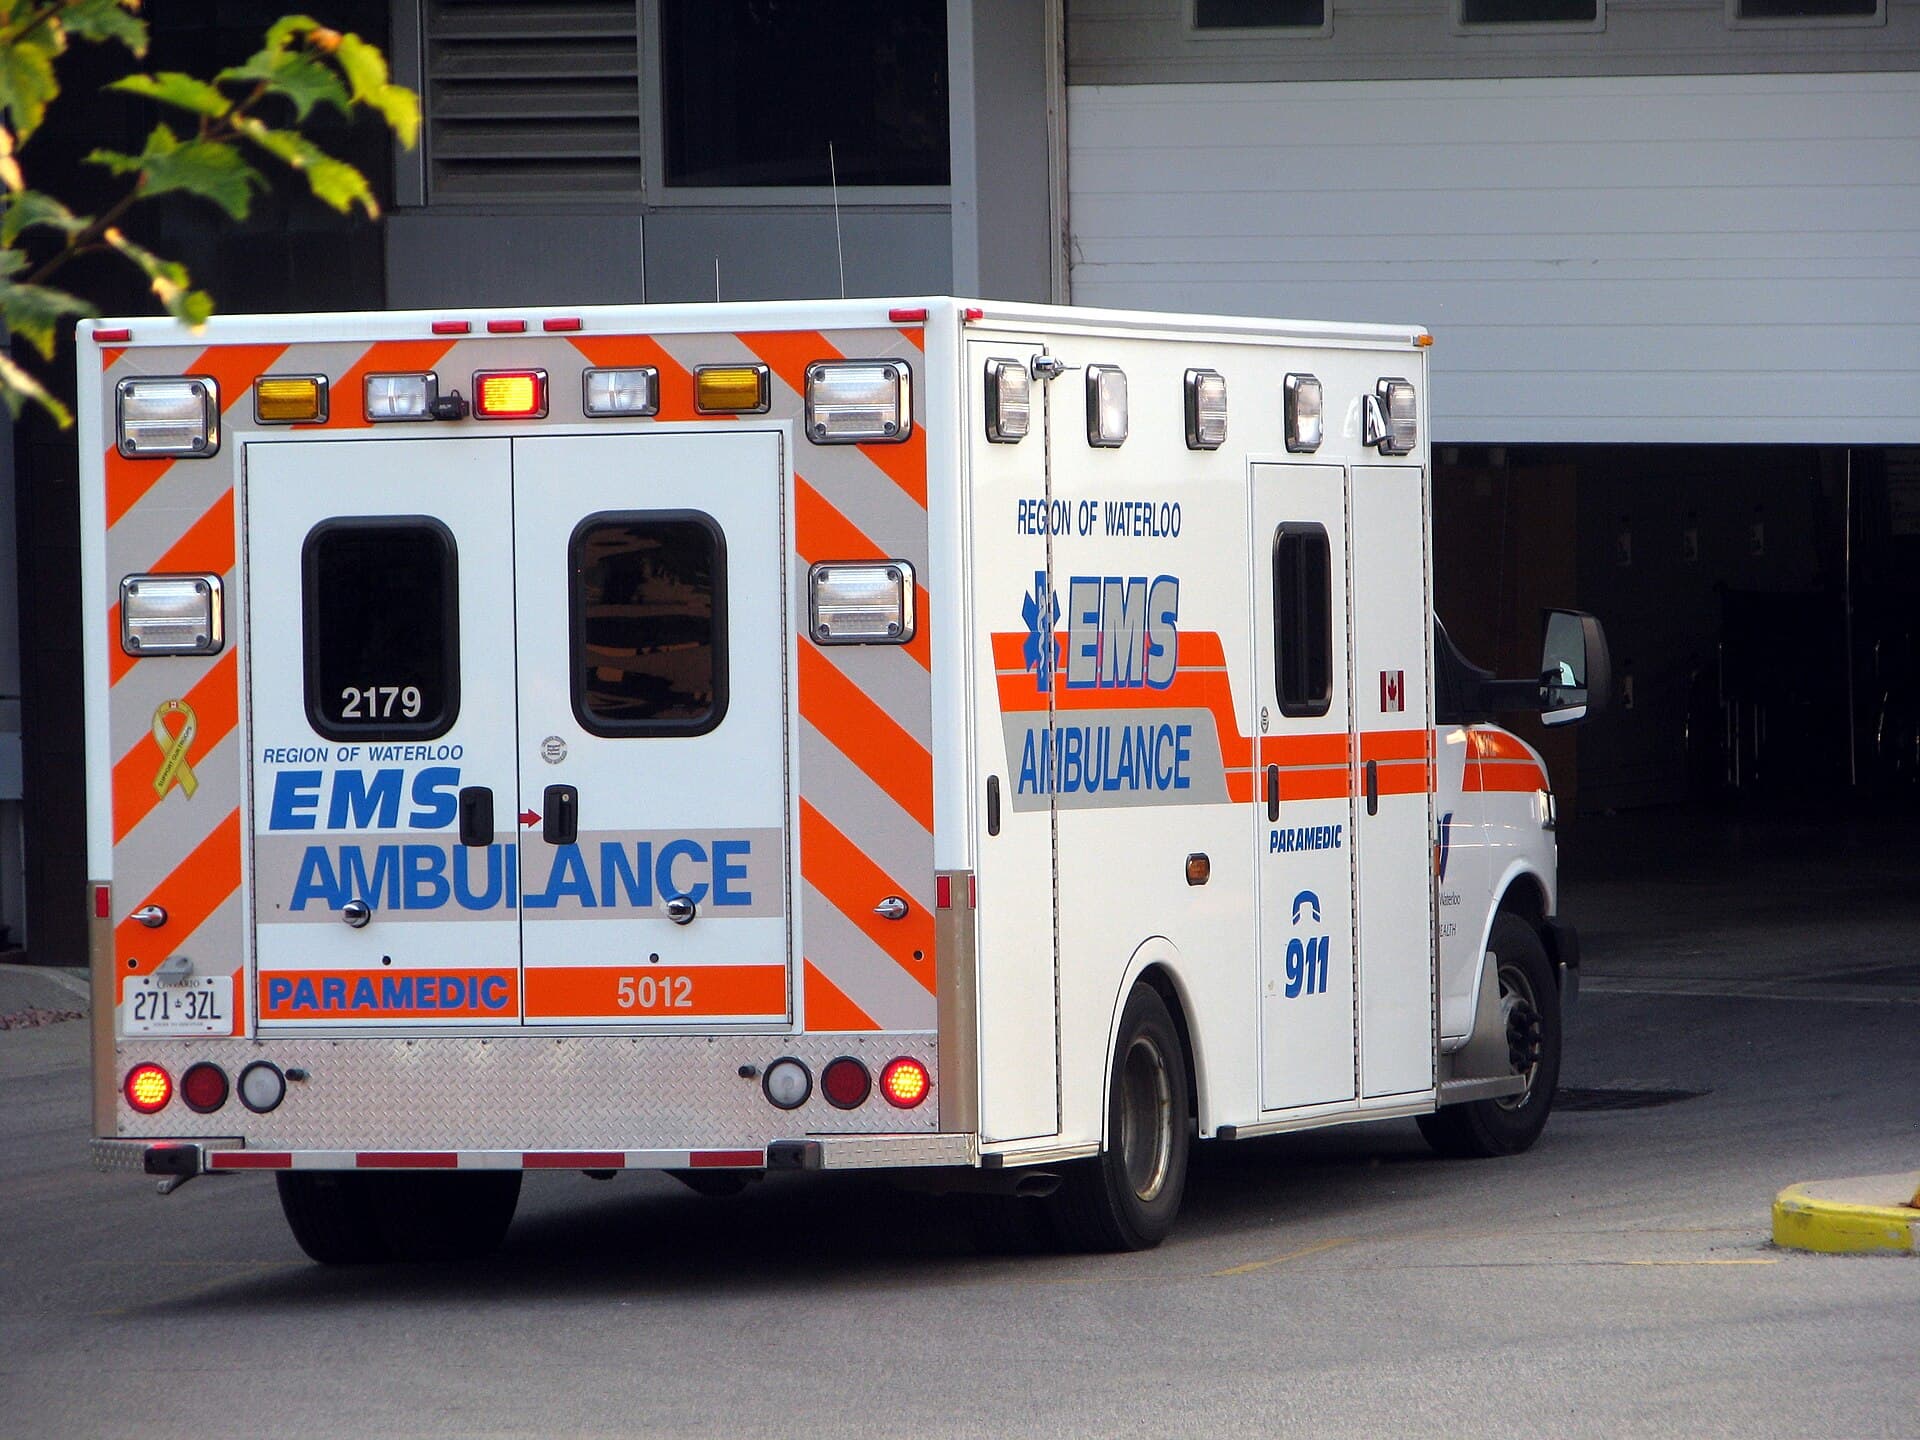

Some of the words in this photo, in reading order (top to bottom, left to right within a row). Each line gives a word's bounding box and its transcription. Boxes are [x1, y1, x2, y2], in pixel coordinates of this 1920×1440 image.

[1017, 498, 1071, 535] REGON
[1078, 500, 1098, 536] OF
[1105, 501, 1181, 538] WATERLOO
[1066, 574, 1179, 690] EMS
[341, 686, 422, 718] 2179
[263, 747, 328, 763] REGION
[336, 747, 361, 762] OF
[368, 745, 464, 761] WATERLOO
[1018, 724, 1192, 794] AMBULANCE
[269, 767, 461, 830] EMS
[1269, 824, 1342, 853] PARAMEDIC
[289, 839, 752, 911] AMBULANCE
[1439, 922, 1457, 937] EALTH
[1285, 936, 1330, 999] 911
[135, 991, 170, 1020] 271
[185, 991, 222, 1020] 3ZL
[268, 975, 509, 1010] PARAMEDIC
[617, 976, 692, 1008] 5012
